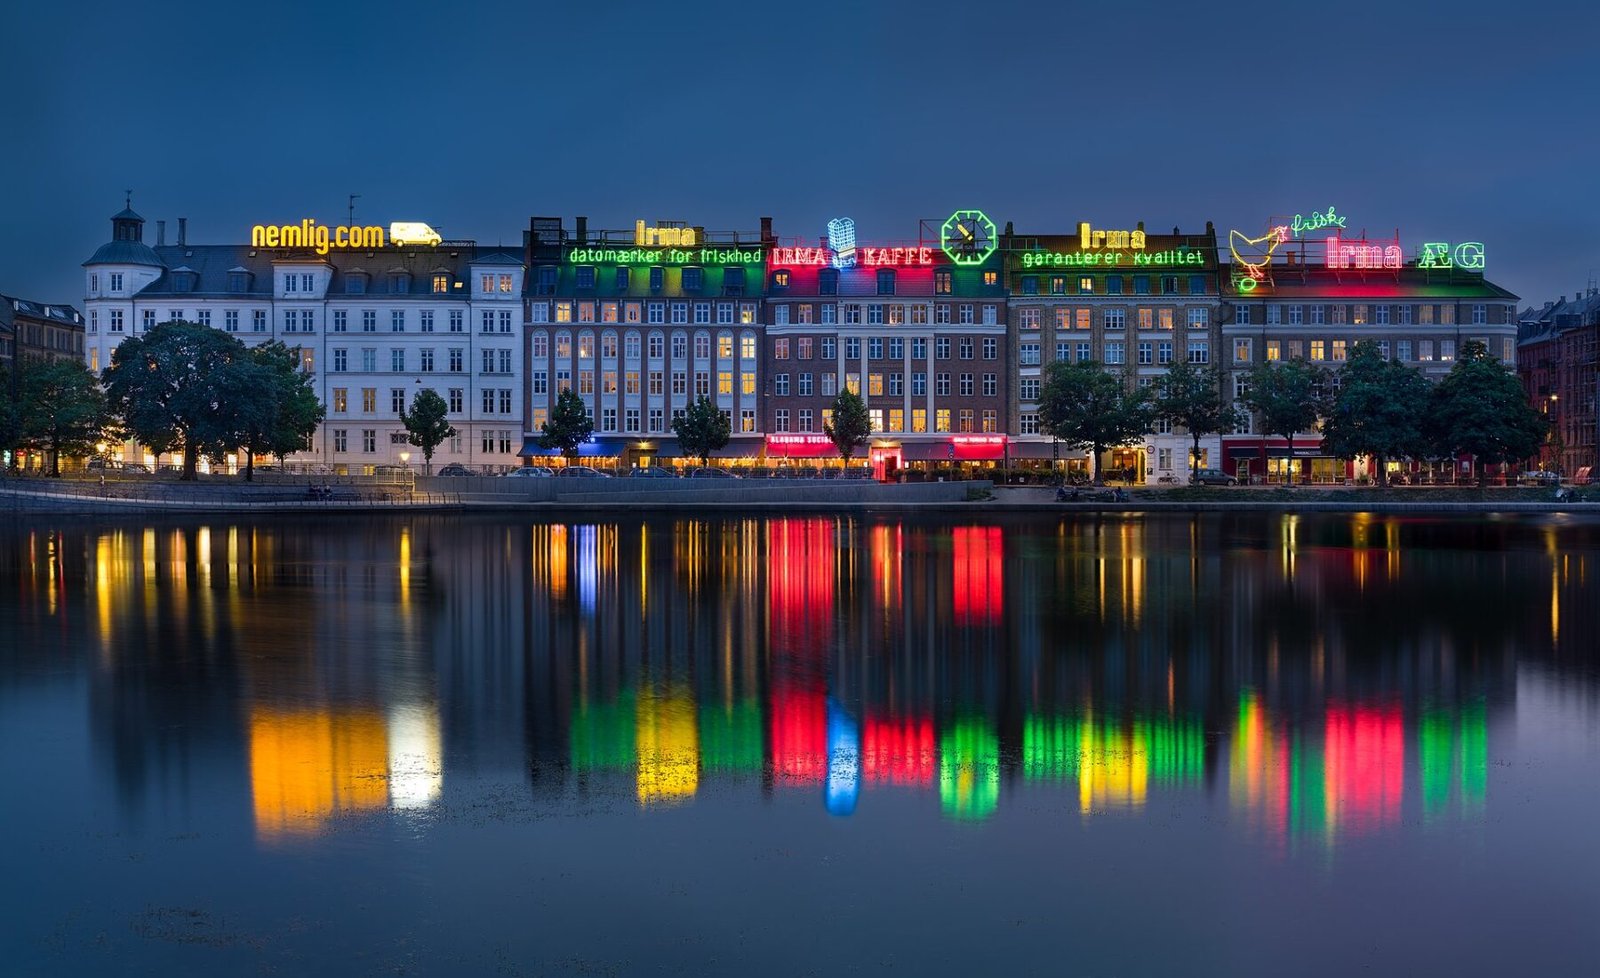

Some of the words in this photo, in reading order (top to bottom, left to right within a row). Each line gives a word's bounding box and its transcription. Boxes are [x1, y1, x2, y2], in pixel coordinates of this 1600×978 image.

[635, 219, 696, 246] Irma
[1291, 206, 1346, 237] friske
[252, 219, 384, 254] nemlig.com
[1081, 222, 1146, 249] Irma
[570, 247, 663, 263] datomærker
[670, 248, 693, 263] for
[701, 248, 761, 263] friskhed
[772, 247, 827, 265] IRMA
[863, 247, 933, 265] KAFFE
[1023, 251, 1123, 267] garanterer
[1134, 250, 1205, 265] kvalitet
[1327, 236, 1403, 269] Irma
[1418, 242, 1485, 269] ÆG
